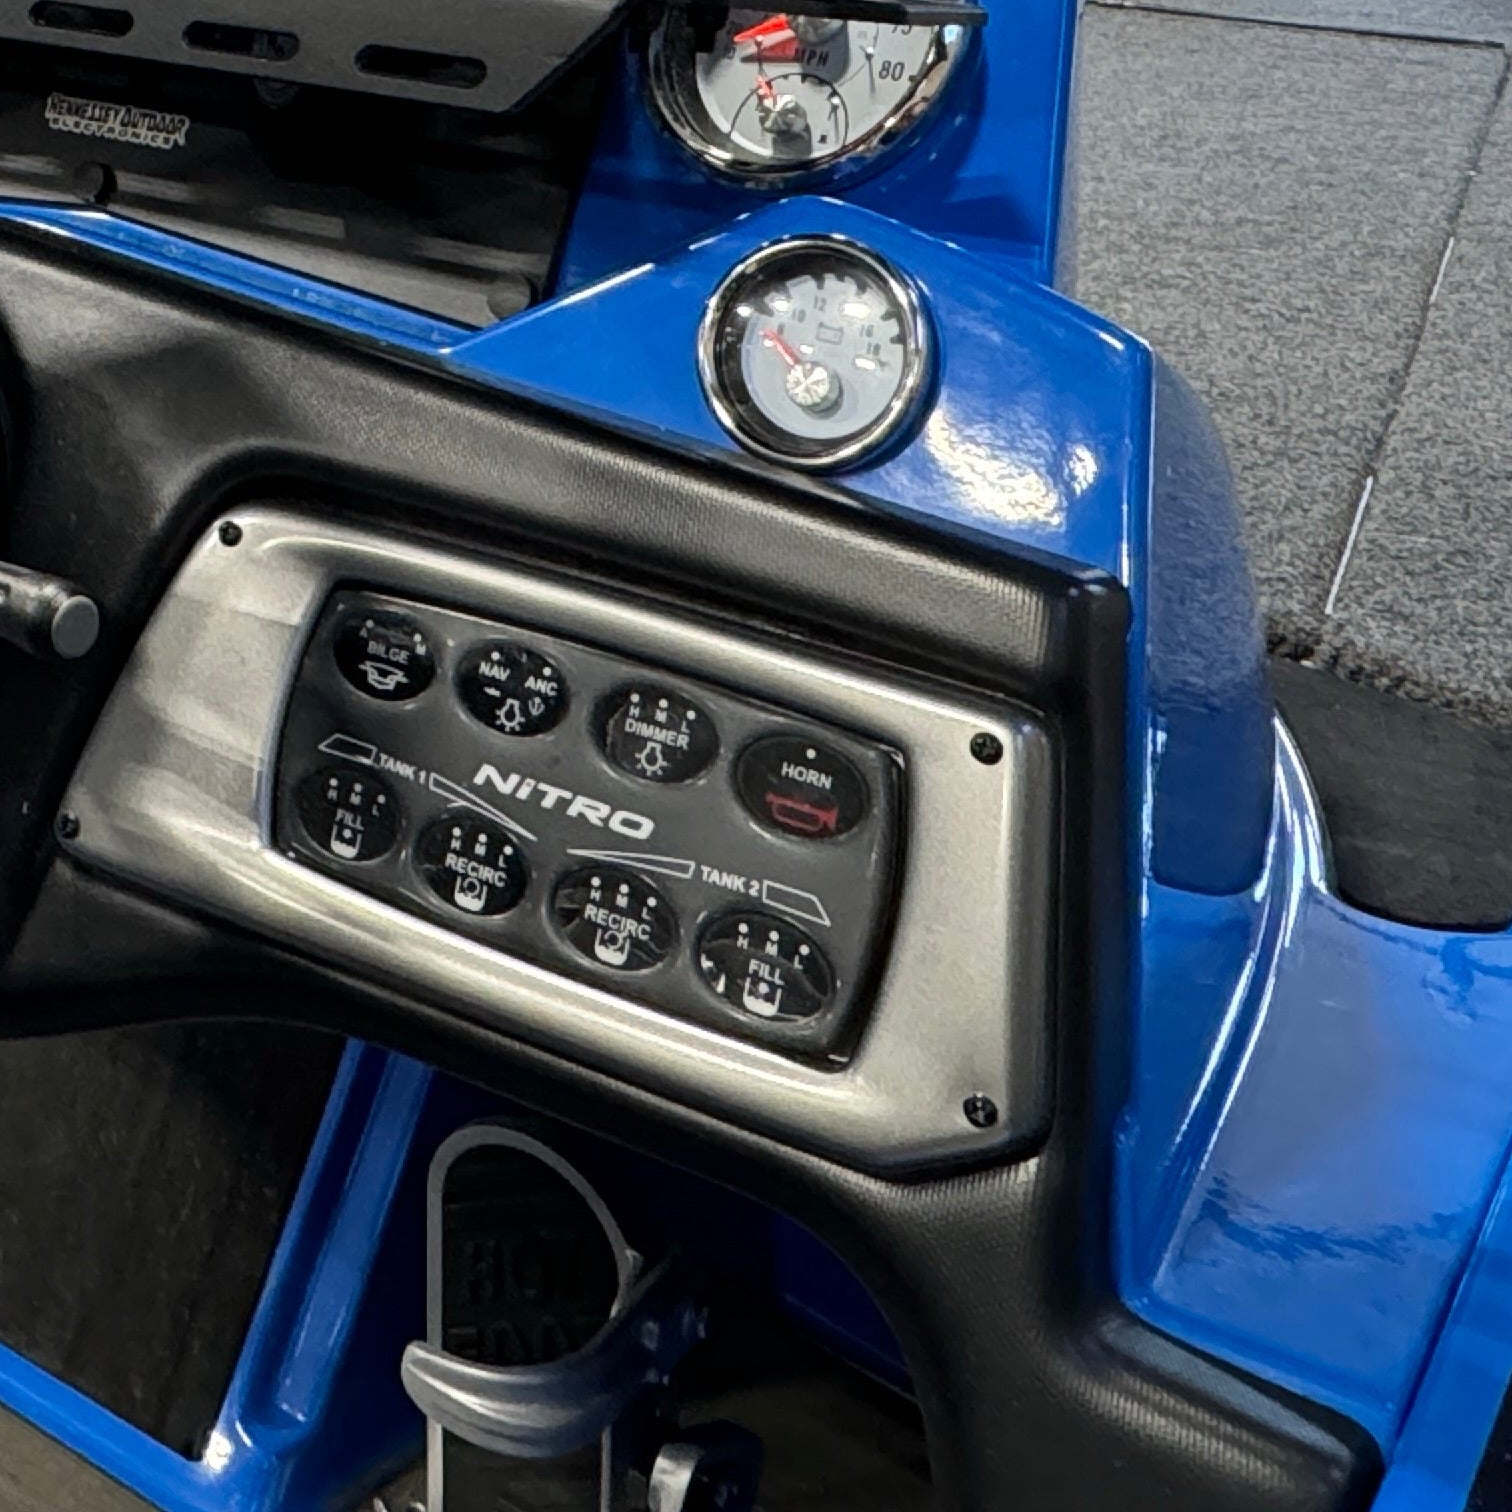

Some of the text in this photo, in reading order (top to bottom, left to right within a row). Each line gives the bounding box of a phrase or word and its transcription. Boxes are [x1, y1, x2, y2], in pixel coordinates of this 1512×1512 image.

[878, 60, 905, 82] 80
[50, 116, 173, 146] ELECTRONICS
[367, 640, 409, 665] BILGE
[479, 661, 558, 697] NAV ANC
[625, 718, 689, 750] DIMMER
[629, 705, 690, 734] H M L
[379, 752, 426, 785] TANK 1
[781, 761, 833, 790] HORN
[336, 808, 364, 832] FILL
[444, 852, 507, 888] RECIRC
[498, 854, 507, 868] L
[700, 864, 760, 897] TANK 2
[590, 888, 651, 920] H M L
[584, 903, 651, 940] RECIRC
[736, 934, 803, 970] H M L
[748, 958, 785, 986] FILL
